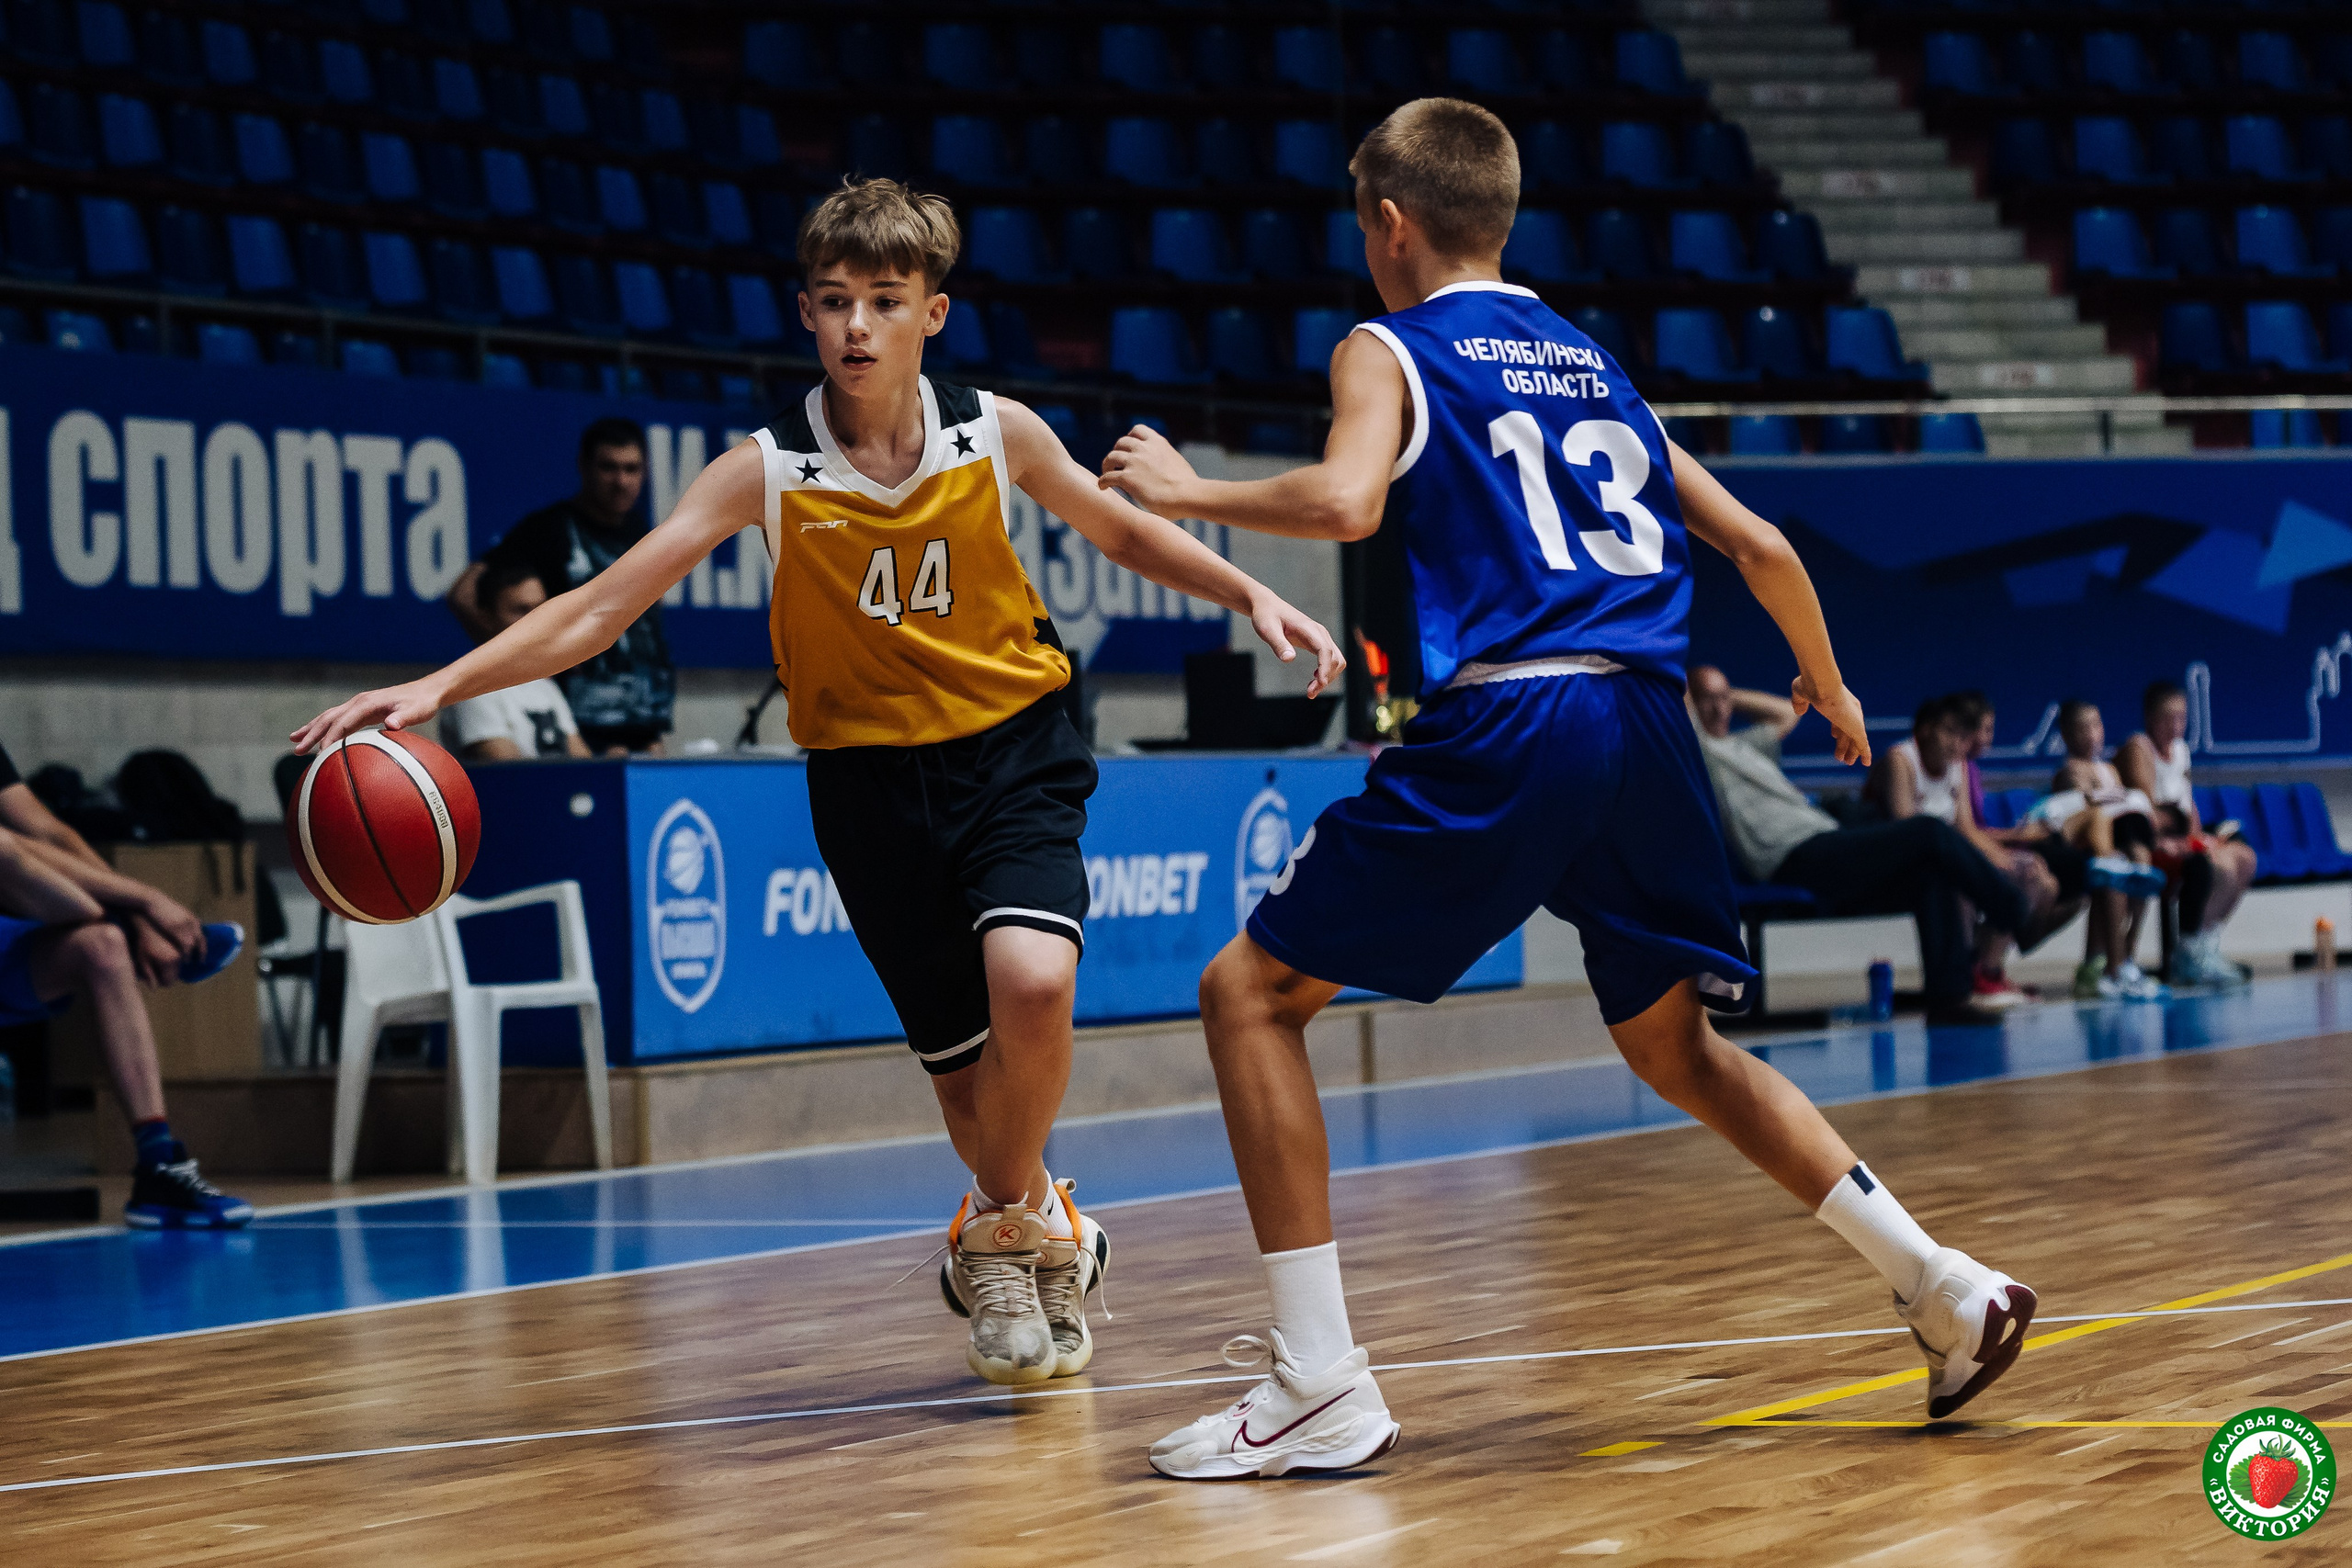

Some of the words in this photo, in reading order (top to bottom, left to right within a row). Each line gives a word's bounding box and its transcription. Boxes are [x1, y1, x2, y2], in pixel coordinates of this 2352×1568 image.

[1501, 368, 1610, 400] ОБЛАСТЬ
[1487, 410, 1665, 577] 13
[855, 537, 955, 627] 44
[763, 867, 852, 936] FON
[1083, 851, 1208, 919] ONBET
